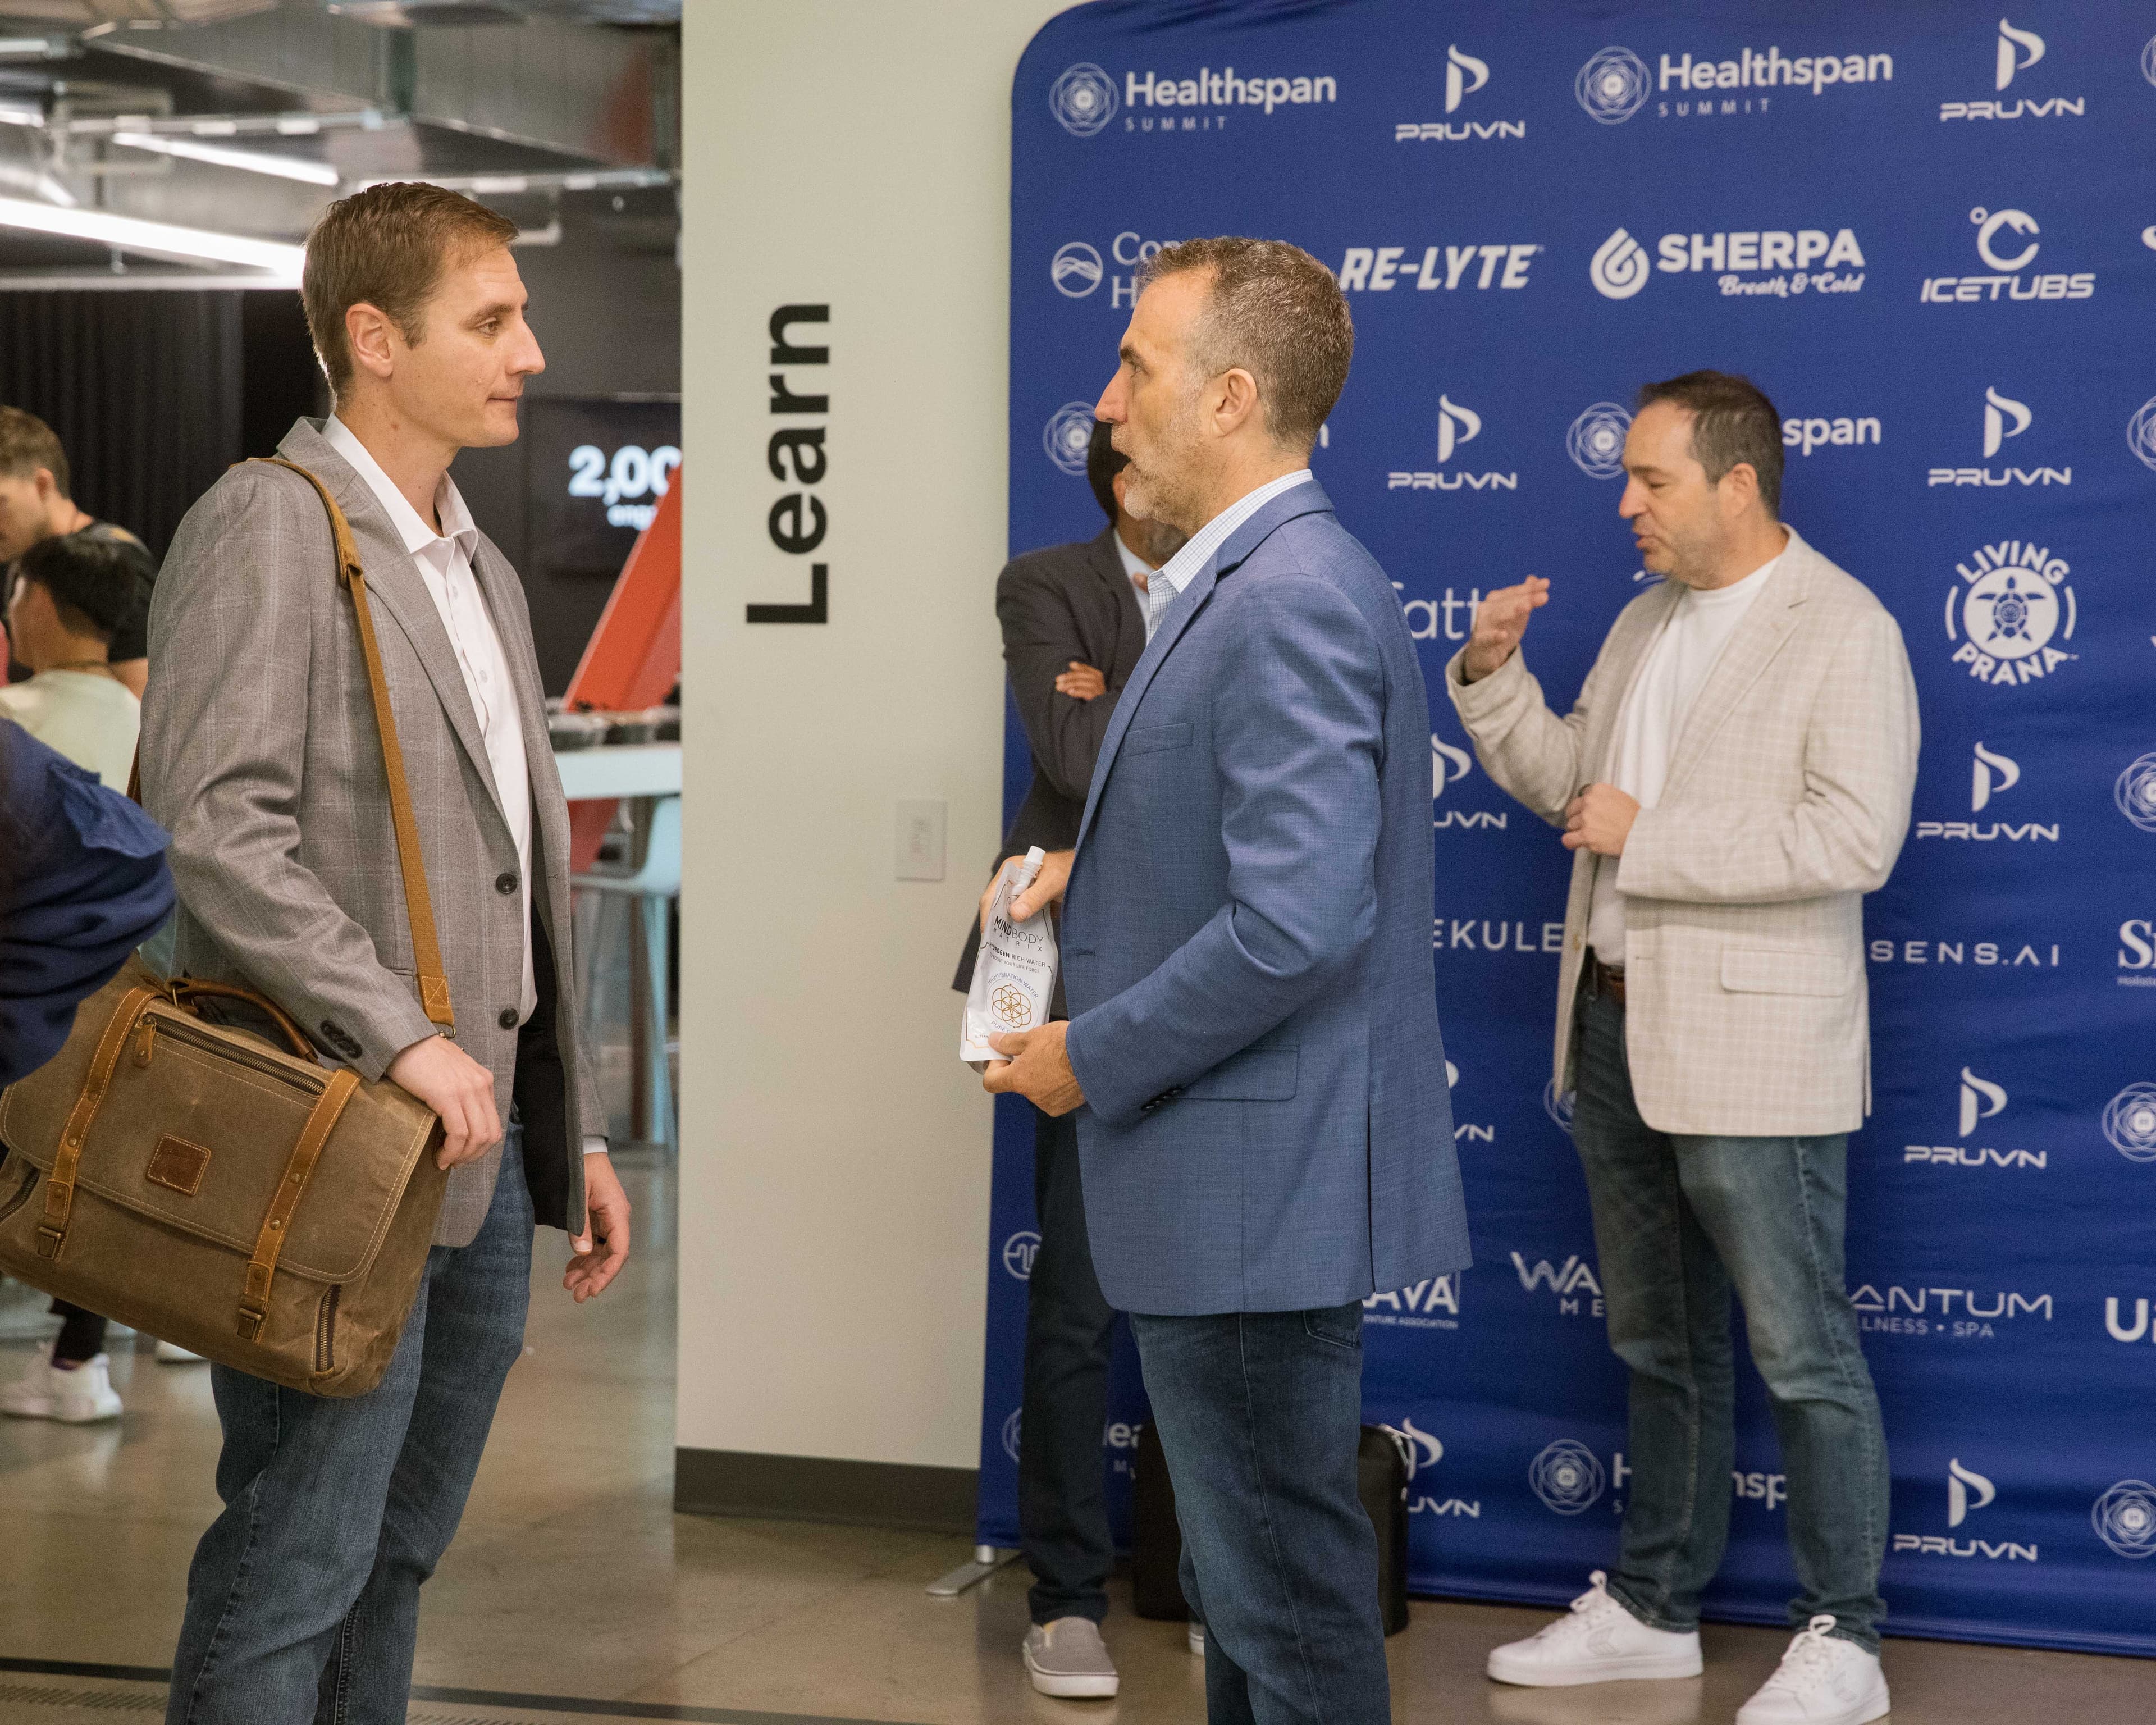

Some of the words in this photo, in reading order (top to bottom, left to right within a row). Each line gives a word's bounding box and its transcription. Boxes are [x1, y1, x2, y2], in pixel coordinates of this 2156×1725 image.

[1659, 47, 1893, 95] Healthspan
[1126, 67, 1337, 114] Healthspan
[1659, 98, 1771, 117] SUMMIT
[1940, 97, 2085, 121] PRUVN
[1125, 116, 1227, 132] SUMMIT
[1395, 120, 1525, 142] PRUVN
[1657, 229, 1866, 273] SHERPA
[1340, 244, 1537, 291] RE-LYTE
[1718, 273, 1789, 298] Breath
[1811, 271, 1865, 293] Cold
[1920, 273, 2095, 303] ICETUBS
[746, 303, 830, 624] Learn
[1928, 467, 2071, 487] PRUVN
[1387, 472, 1518, 490] PRUVN
[1956, 540, 2070, 585] LIVING
[1951, 641, 2070, 686] PRANA
[1916, 822, 2060, 842] PRUVN
[993, 928, 1043, 952] MATRIX
[994, 916, 1043, 945] MINDBODY
[2118, 919, 2156, 969] S
[1011, 953, 1025, 962] RICH
[1026, 958, 1045, 967] WATER
[1870, 940, 2059, 967] SENS.AI
[997, 972, 1023, 984] VIBRATION
[1023, 981, 1039, 998] WATER
[1904, 1146, 2047, 1169] PRUVN
[1953, 1321, 1994, 1338] SPA
[1894, 1534, 2038, 1562] PRUVN
